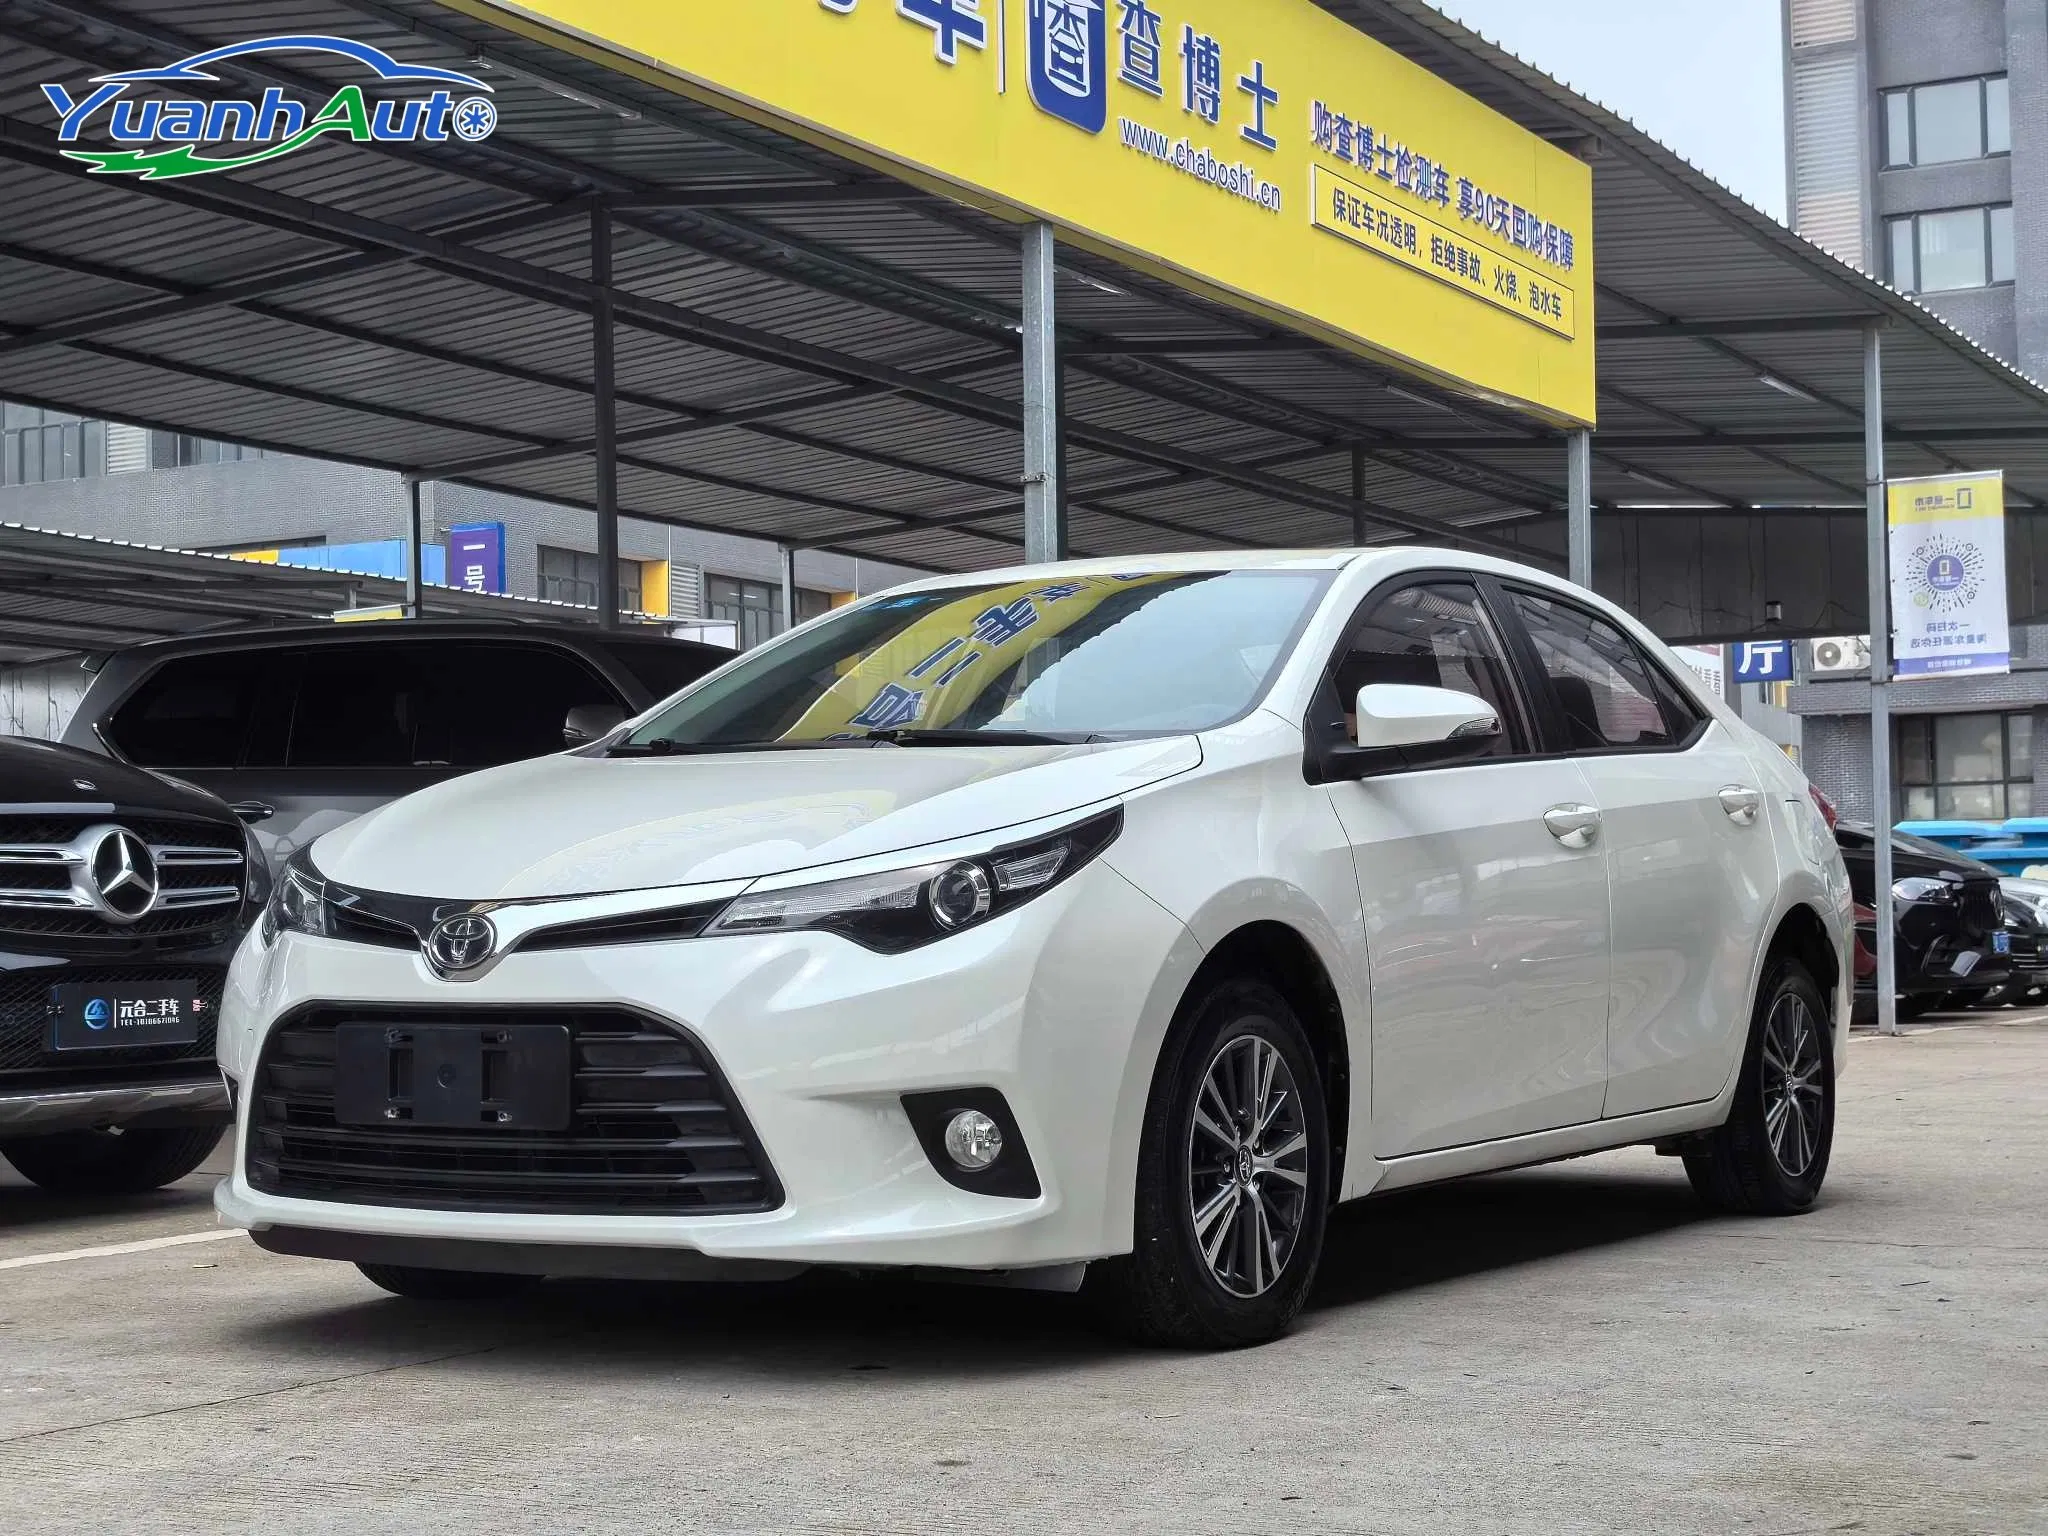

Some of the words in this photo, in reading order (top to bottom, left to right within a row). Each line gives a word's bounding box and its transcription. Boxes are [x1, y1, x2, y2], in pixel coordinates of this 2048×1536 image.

[1117, 0, 1279, 151] 查博士
[1118, 116, 1282, 211] www.chaboshi.cn
[1311, 99, 1450, 208] 购查博士检测车
[1456, 175, 1575, 272] 享90天回购保障
[463, 543, 485, 591] 一号
[1738, 641, 1783, 675] 厅
[120, 998, 179, 1018] 元合二手车
